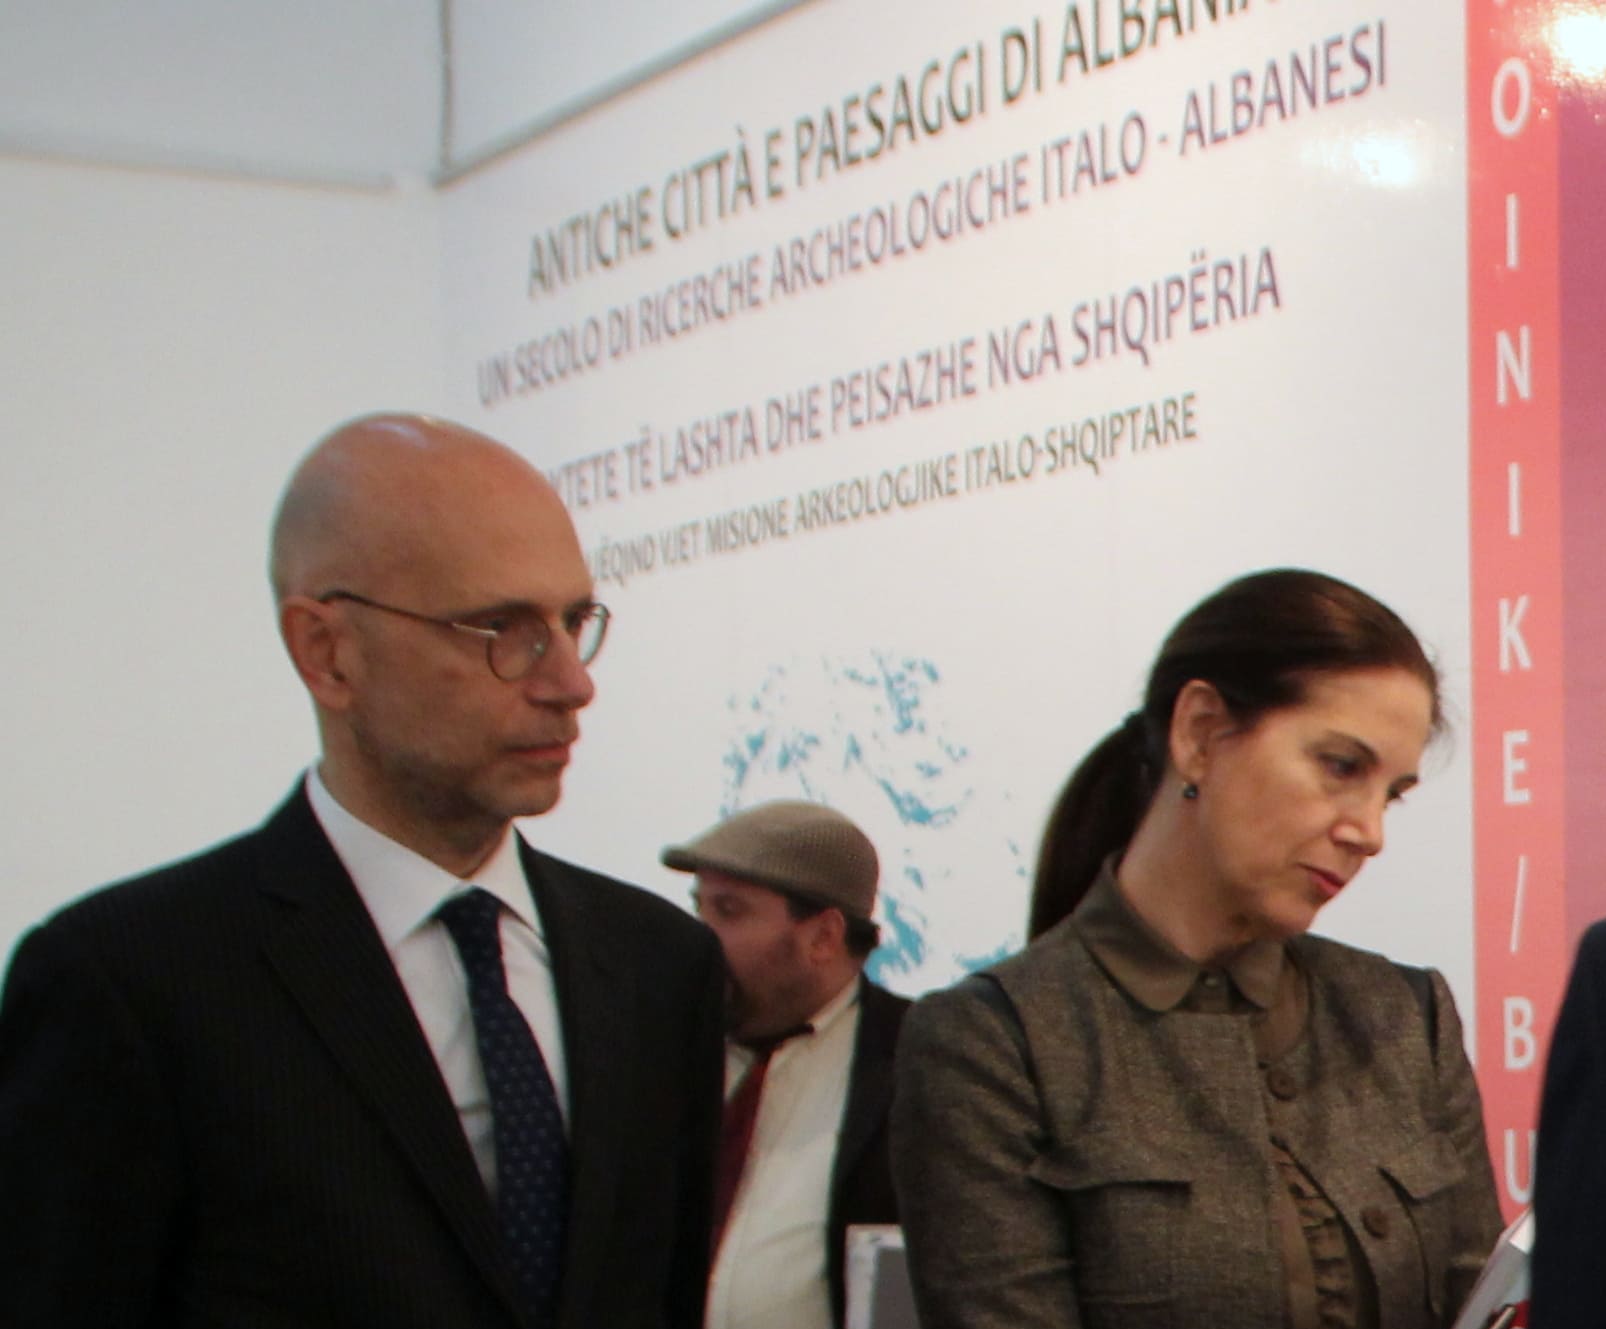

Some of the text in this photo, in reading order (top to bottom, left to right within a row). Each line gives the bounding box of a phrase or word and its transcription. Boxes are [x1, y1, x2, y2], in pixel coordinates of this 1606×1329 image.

[477, 350, 512, 408] UN
[514, 316, 600, 394] SECOLO
[607, 305, 633, 359] DI
[638, 255, 762, 346] RICERCHE
[768, 154, 1029, 301] ARCHEOLOGICHE
[1040, 110, 1147, 205] ITALO
[1180, 19, 1388, 158] ALBANESI
[528, 0, 1278, 298] ANTICHE CITTÀ E PAESAGGI DI ALBA
[624, 423, 654, 492] TË
[659, 405, 759, 483] LASHTA
[765, 385, 822, 452] DHE
[830, 338, 976, 434] PEISAZHE
[986, 313, 1062, 390] NGA
[1071, 246, 1282, 368] SHQIPËRIA
[660, 520, 700, 569] VJET
[705, 500, 790, 556] MISIONE
[794, 452, 958, 534] ARKEOLOGJIKE
[965, 392, 1198, 477] ITALO-SHQIPTARE
